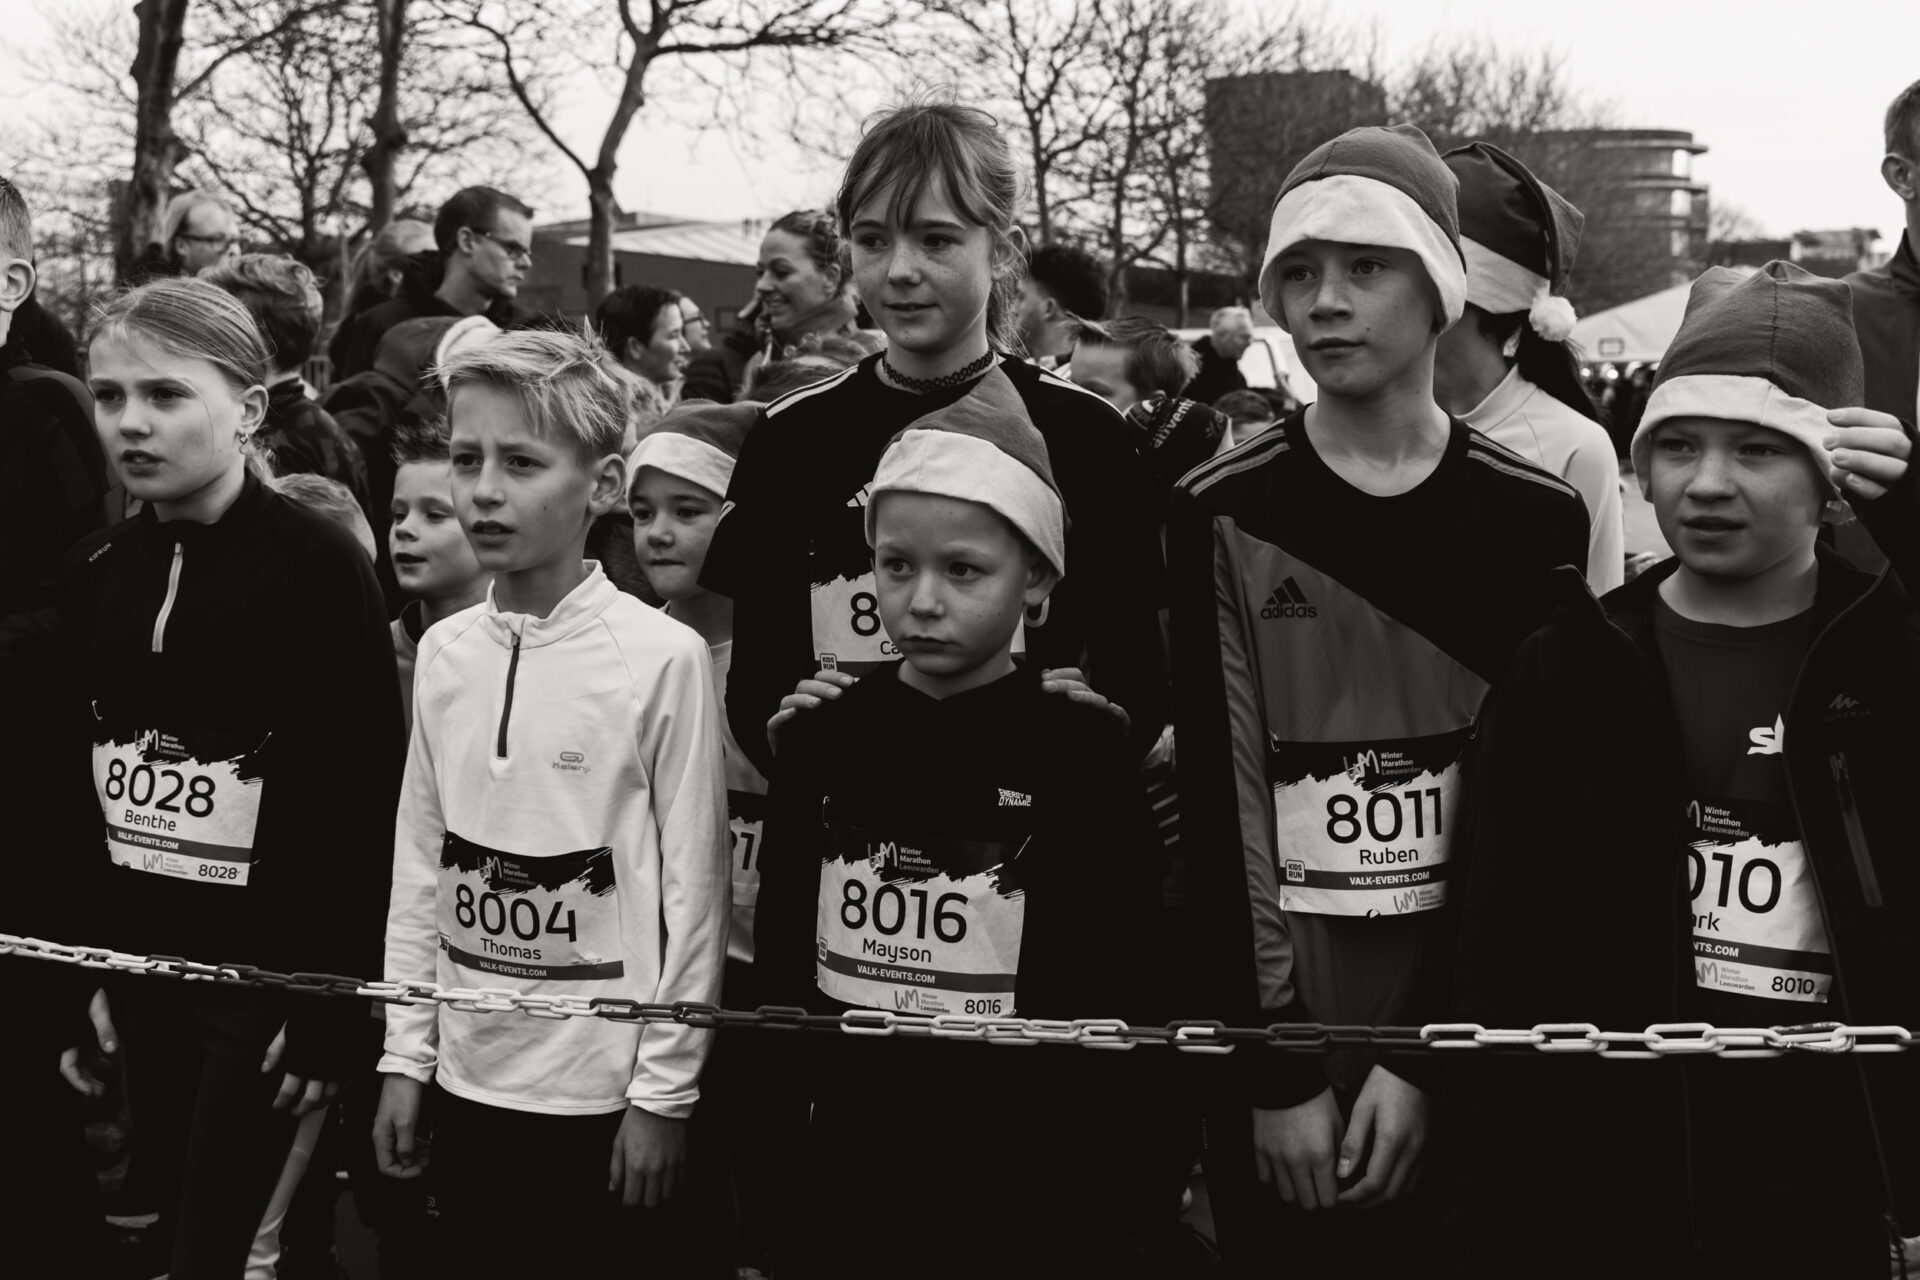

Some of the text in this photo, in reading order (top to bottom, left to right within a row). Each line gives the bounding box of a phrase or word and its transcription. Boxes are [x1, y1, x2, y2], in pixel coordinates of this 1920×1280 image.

[1260, 603, 1317, 619] adidas
[1380, 751, 1403, 760] Winter
[1380, 758, 1414, 768] Marathon
[106, 758, 216, 818] 8028
[998, 796, 1031, 807] DYNAMIC
[1326, 787, 1442, 844] 8011
[1704, 805, 1731, 817] Winter
[124, 809, 176, 831] Benthe
[1703, 814, 1741, 827] Marathon
[1702, 823, 1749, 837] Leeuwarden
[117, 830, 179, 850] VALK-EVENTS.COM
[900, 846, 922, 856] Winter
[1360, 847, 1419, 865] Ruben
[899, 854, 931, 865] Marathon
[1288, 863, 1302, 871] KIDS
[198, 864, 237, 880] 8028
[503, 867, 528, 878] Marathon
[1288, 870, 1303, 879] RUN
[1349, 871, 1430, 886] VALK-EVENTS.COM
[455, 883, 577, 942] 8004
[840, 879, 968, 943] 8016
[480, 937, 542, 960] Thomas
[862, 938, 932, 963] Mayson
[479, 960, 547, 977] VALK-EVENTS.COM
[857, 964, 936, 984] VALK-EVENTS.COM
[1772, 976, 1815, 995] 8010
[965, 999, 1002, 1014] 8016
